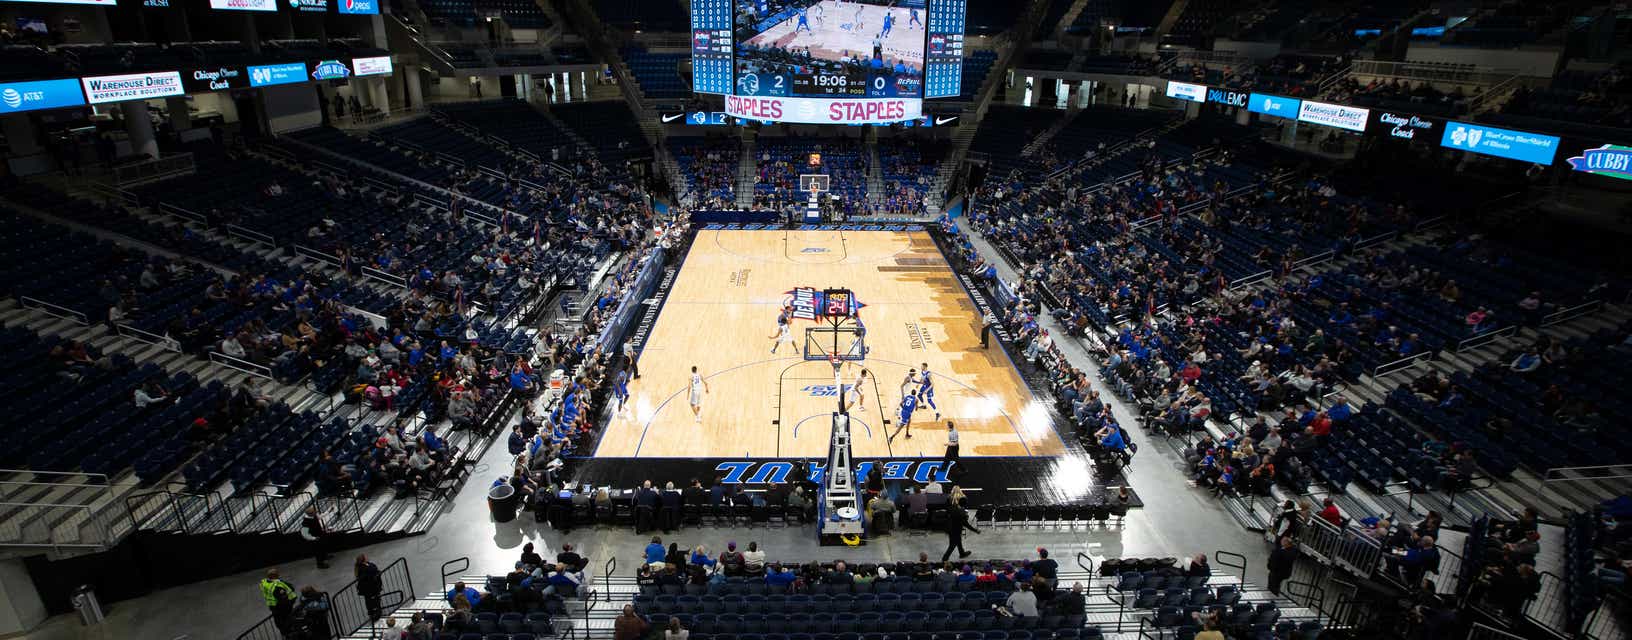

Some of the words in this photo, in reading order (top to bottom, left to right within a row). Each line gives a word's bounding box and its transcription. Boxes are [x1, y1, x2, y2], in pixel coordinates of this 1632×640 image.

[194, 70, 220, 81] Chicago
[774, 75, 784, 88] 2
[813, 75, 847, 87] 19:06
[89, 79, 144, 91] WAREHOUSE
[146, 76, 174, 87] DIRECT
[209, 81, 230, 90] Coach
[874, 77, 886, 90] 0
[23, 91, 44, 102] AT&T
[93, 90, 138, 100] WORKPLACE
[140, 87, 177, 96] SOLUTIONS
[1227, 92, 1247, 107] EMC
[728, 95, 783, 119] STAPLES
[829, 100, 905, 121] STAPLES
[1380, 112, 1409, 126] Chicago
[1391, 126, 1415, 139] Coach
[1587, 152, 1630, 172] CUBBY
[792, 287, 815, 319] DEPAUL
[828, 301, 845, 314] 24
